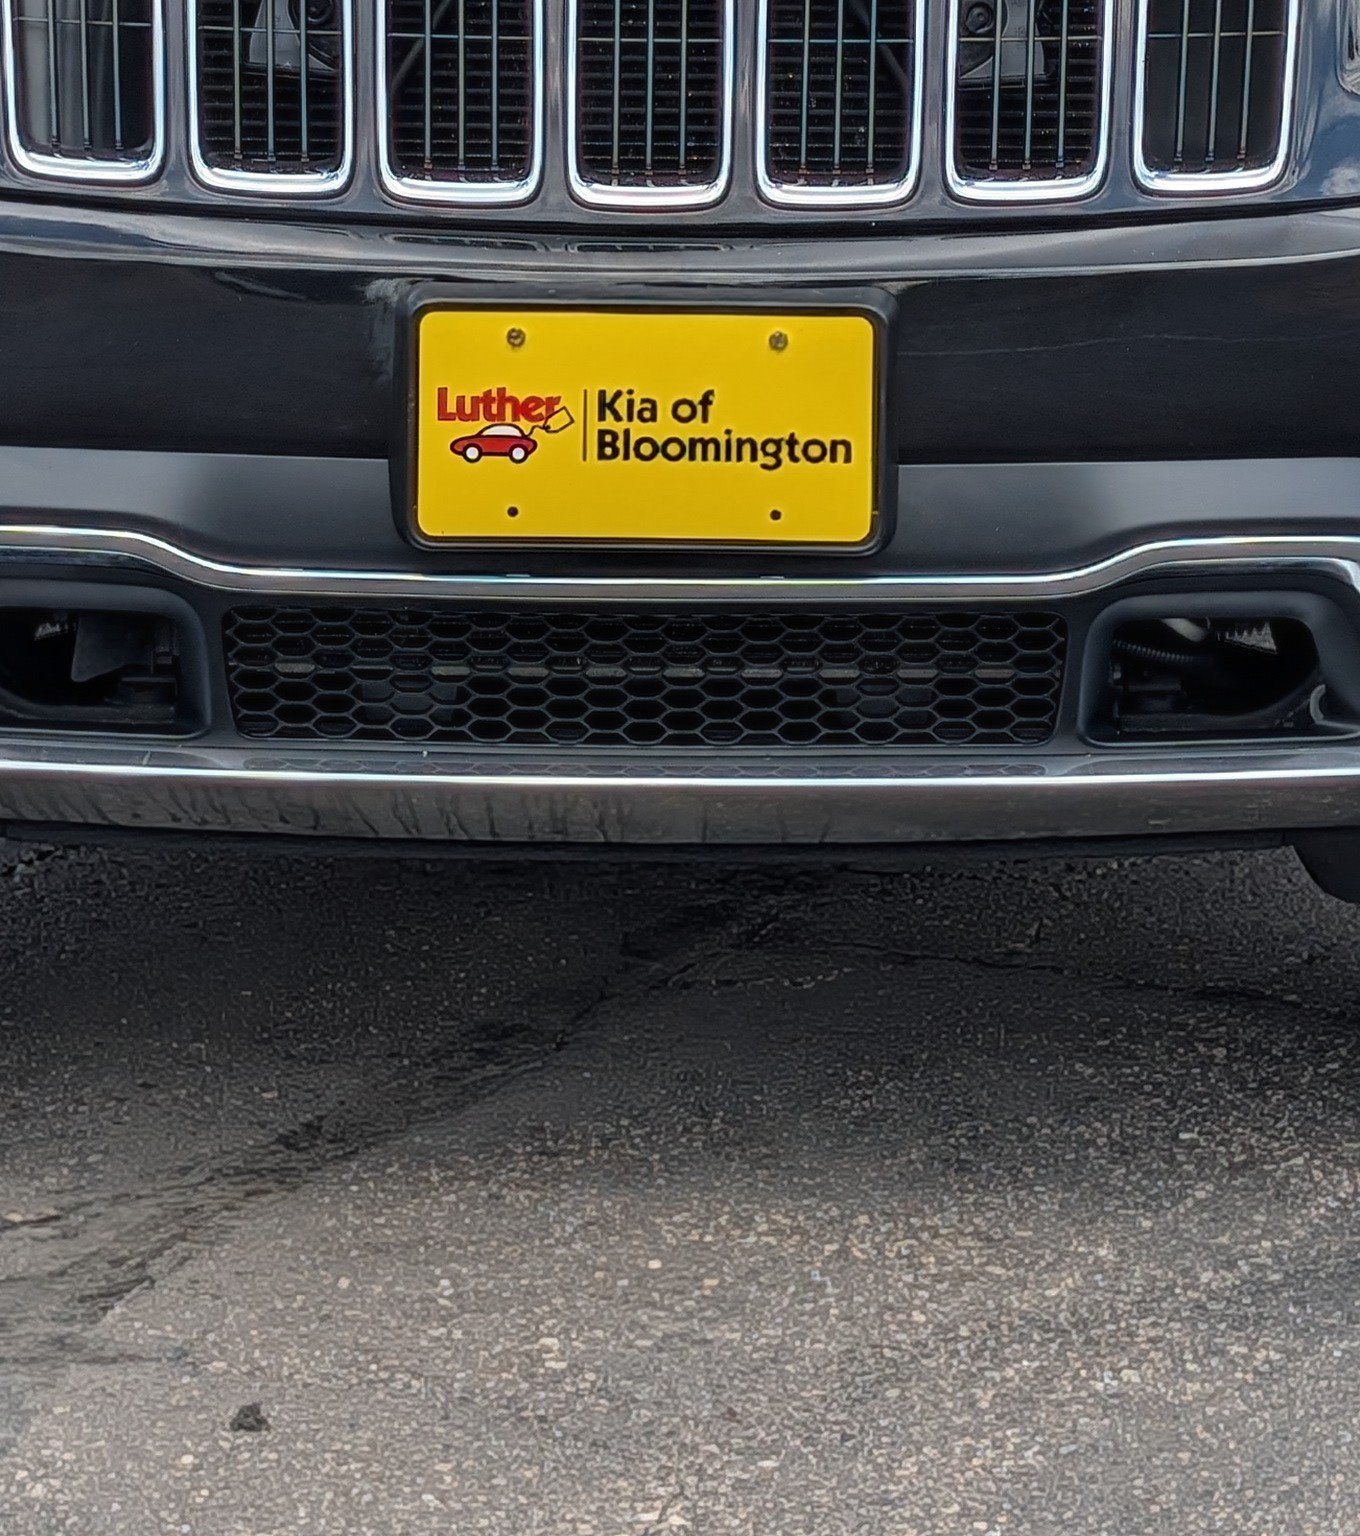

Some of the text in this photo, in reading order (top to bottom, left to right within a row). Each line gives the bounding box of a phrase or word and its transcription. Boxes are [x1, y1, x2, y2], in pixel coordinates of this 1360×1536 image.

[437, 387, 562, 423] Luther
[597, 388, 715, 424] Kia of
[596, 428, 853, 471] Bloomington
